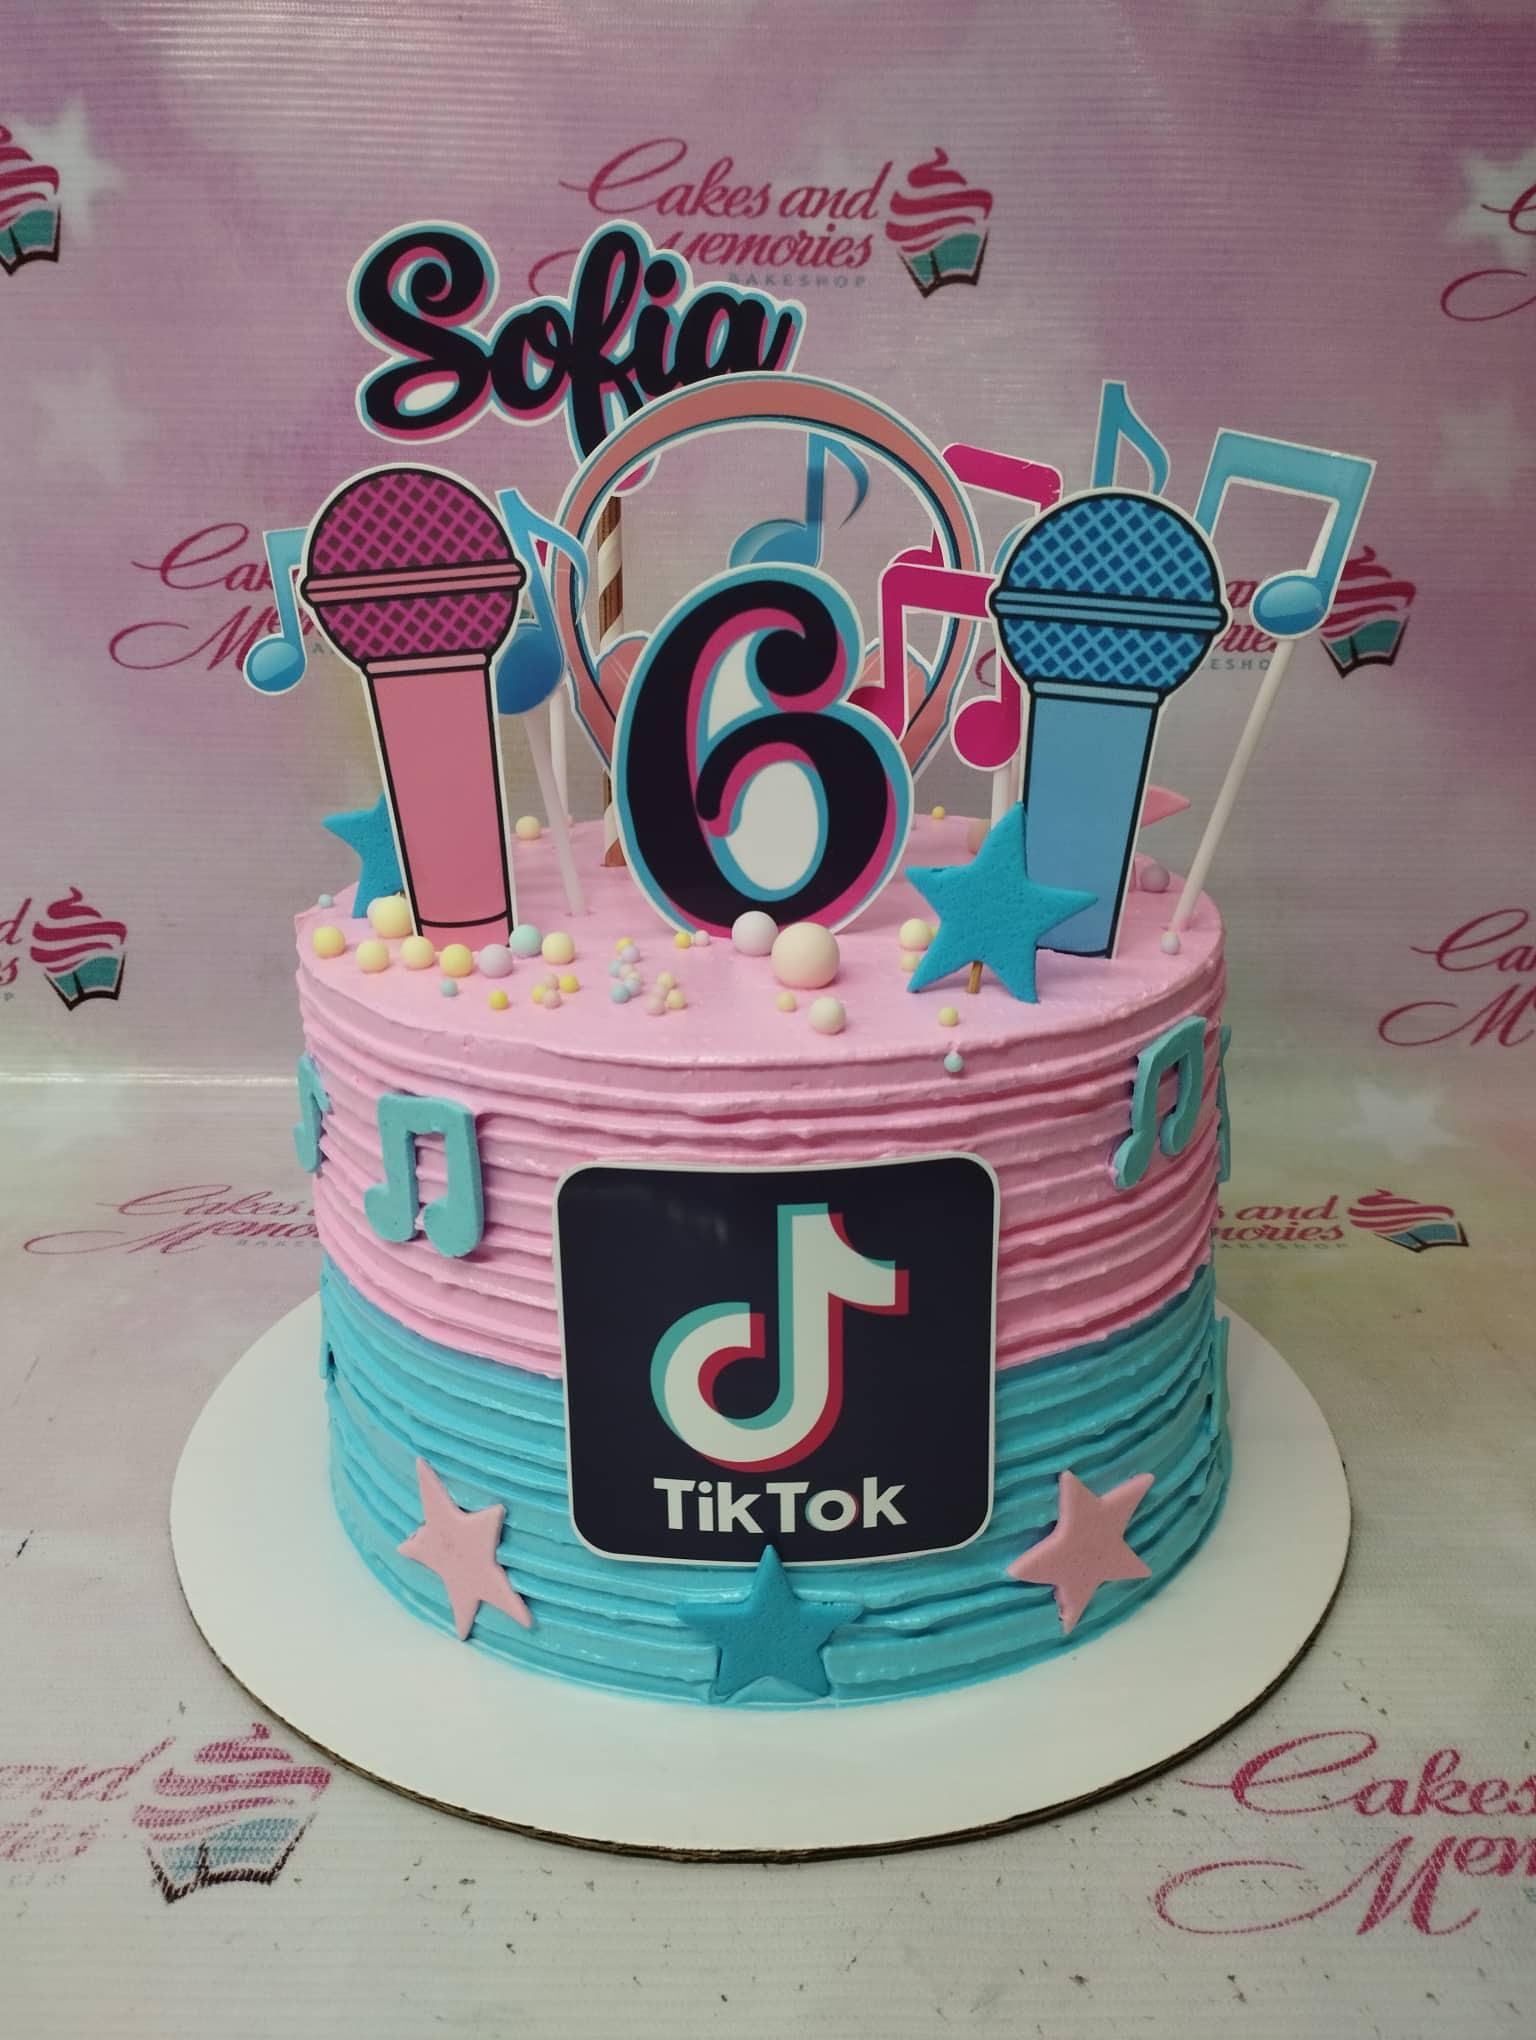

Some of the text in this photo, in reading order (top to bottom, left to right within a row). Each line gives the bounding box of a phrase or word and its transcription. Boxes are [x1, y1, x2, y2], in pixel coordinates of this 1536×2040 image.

[558, 137, 893, 220] Cakes and
[728, 272, 867, 288] BAKESHOP
[352, 225, 803, 492] Sofia
[620, 570, 906, 939] 6
[1235, 1194, 1339, 1220] and
[653, 1476, 908, 1534] TikTok
